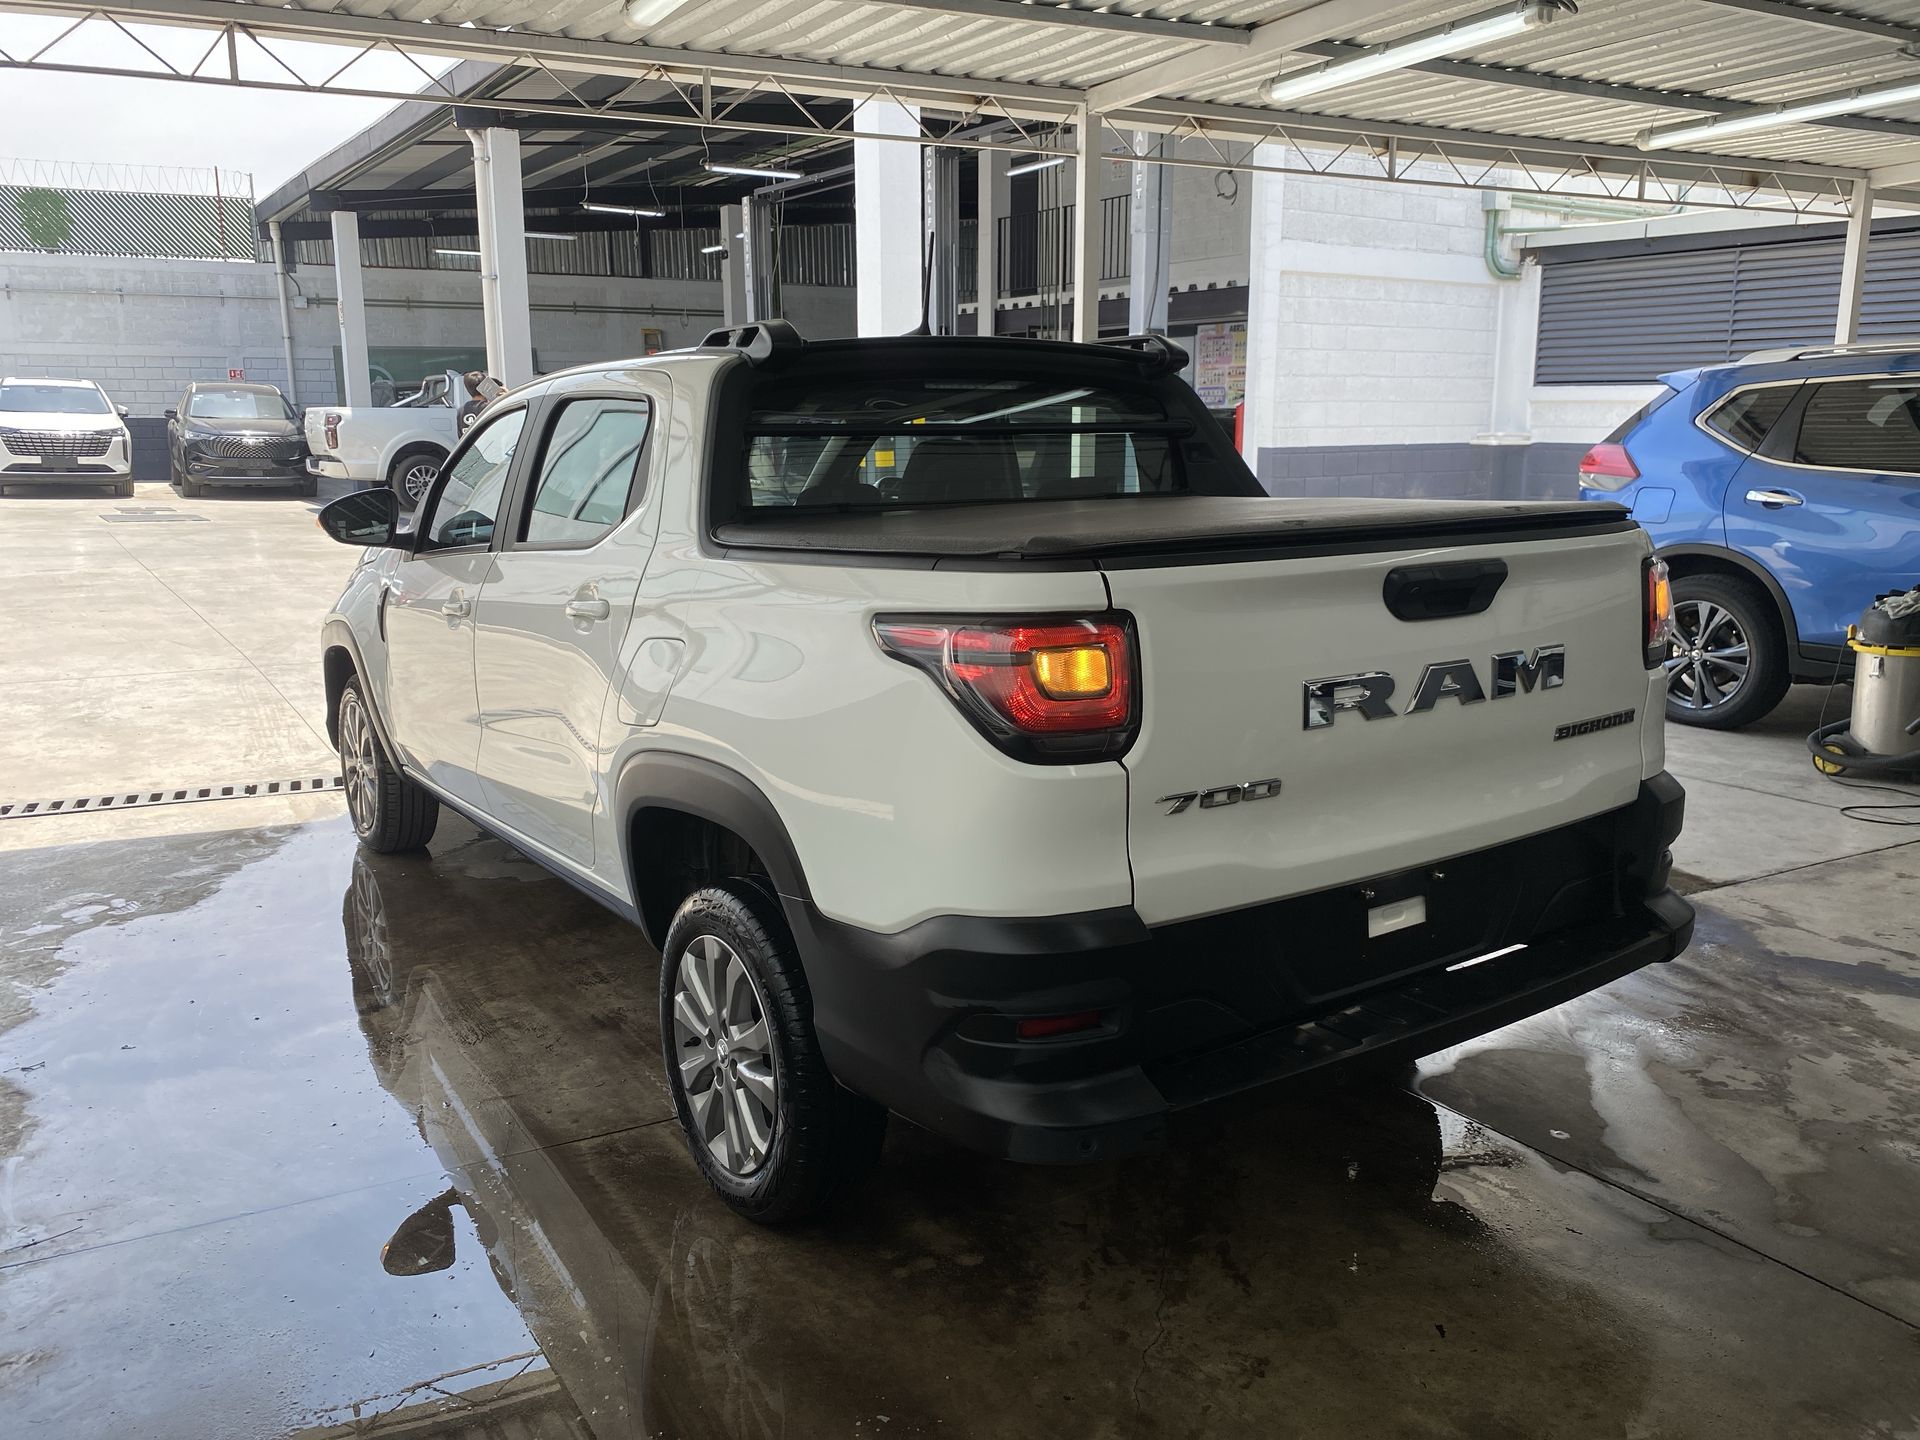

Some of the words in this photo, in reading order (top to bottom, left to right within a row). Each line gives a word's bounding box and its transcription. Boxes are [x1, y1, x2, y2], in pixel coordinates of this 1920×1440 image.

[1135, 131, 1143, 199] ALIFT
[1229, 324, 1246, 332] ABRIL
[1302, 643, 1565, 731] RAM
[1553, 707, 1636, 742] BIGHORN
[1154, 777, 1282, 816] 700
